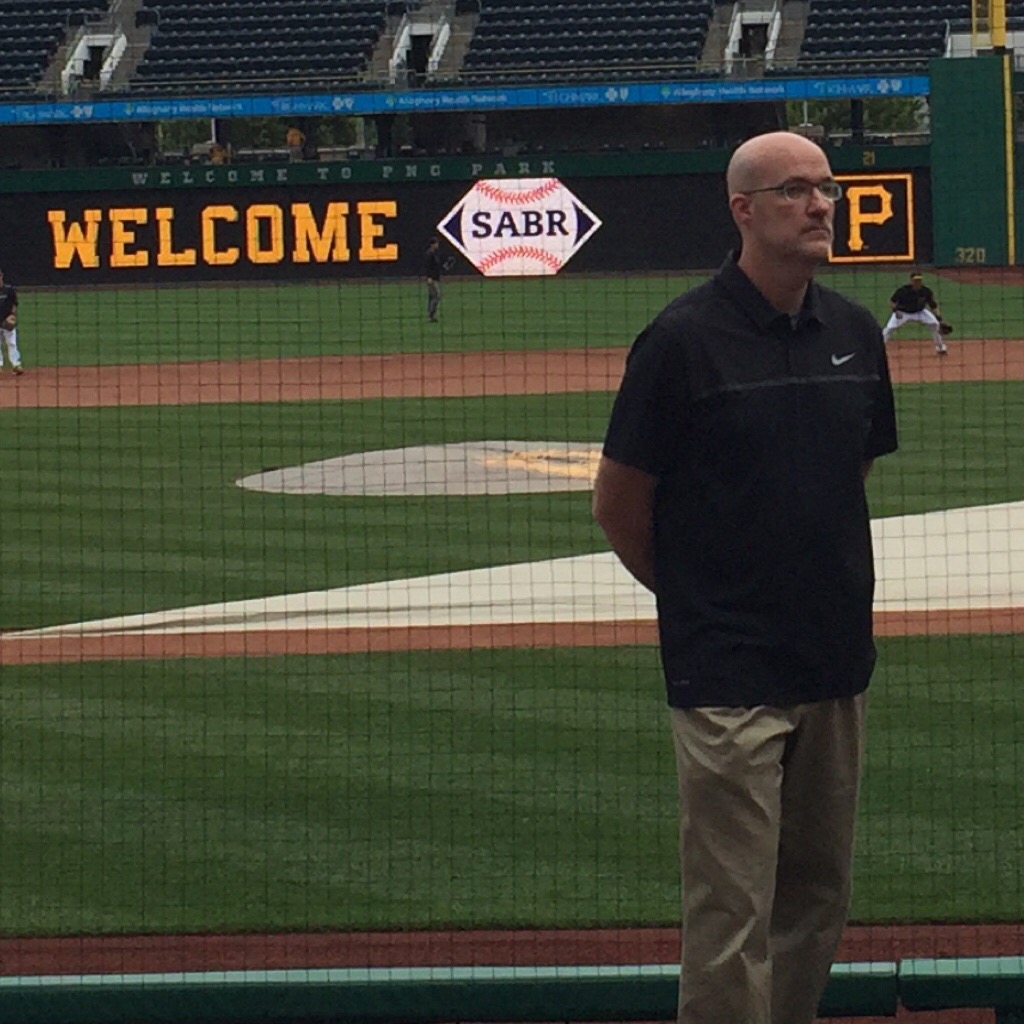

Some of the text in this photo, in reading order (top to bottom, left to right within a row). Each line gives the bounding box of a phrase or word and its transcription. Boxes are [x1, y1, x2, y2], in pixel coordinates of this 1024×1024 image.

[132, 168, 288, 186] WELCOME
[317, 167, 352, 180] TO
[471, 160, 555, 176] PARK
[471, 209, 569, 239] SABR
[846, 184, 894, 251] P
[48, 201, 398, 268] WELCOME
[956, 247, 986, 263] 320
